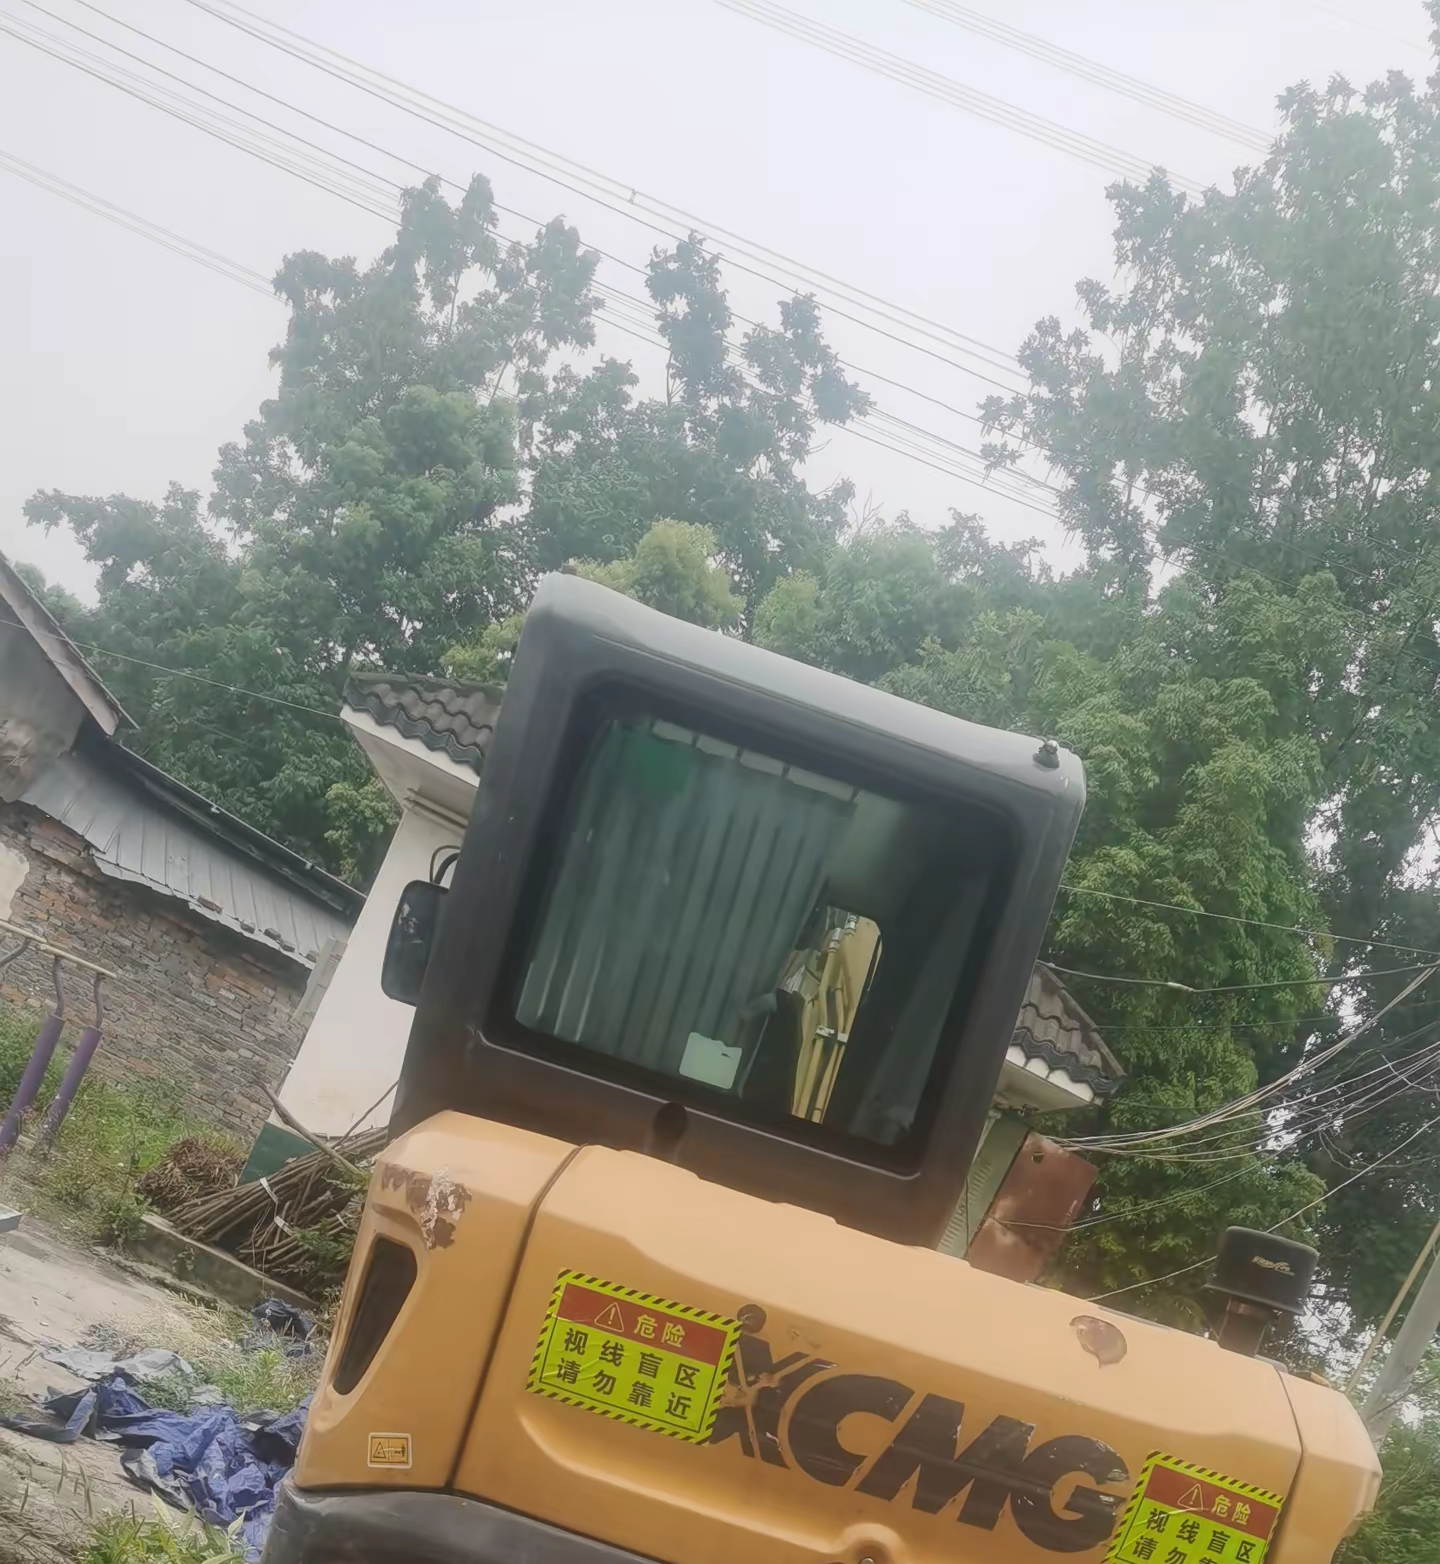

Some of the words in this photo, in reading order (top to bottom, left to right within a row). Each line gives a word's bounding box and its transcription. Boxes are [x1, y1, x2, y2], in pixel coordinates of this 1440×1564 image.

[564, 1327, 700, 1390] 视线盲区
[633, 1313, 687, 1348] 危险
[556, 1357, 692, 1420] 请勿靠近
[709, 1304, 1131, 1553] XCMG
[1145, 1507, 1256, 1564] 视线盲区
[1211, 1494, 1251, 1525] 危险
